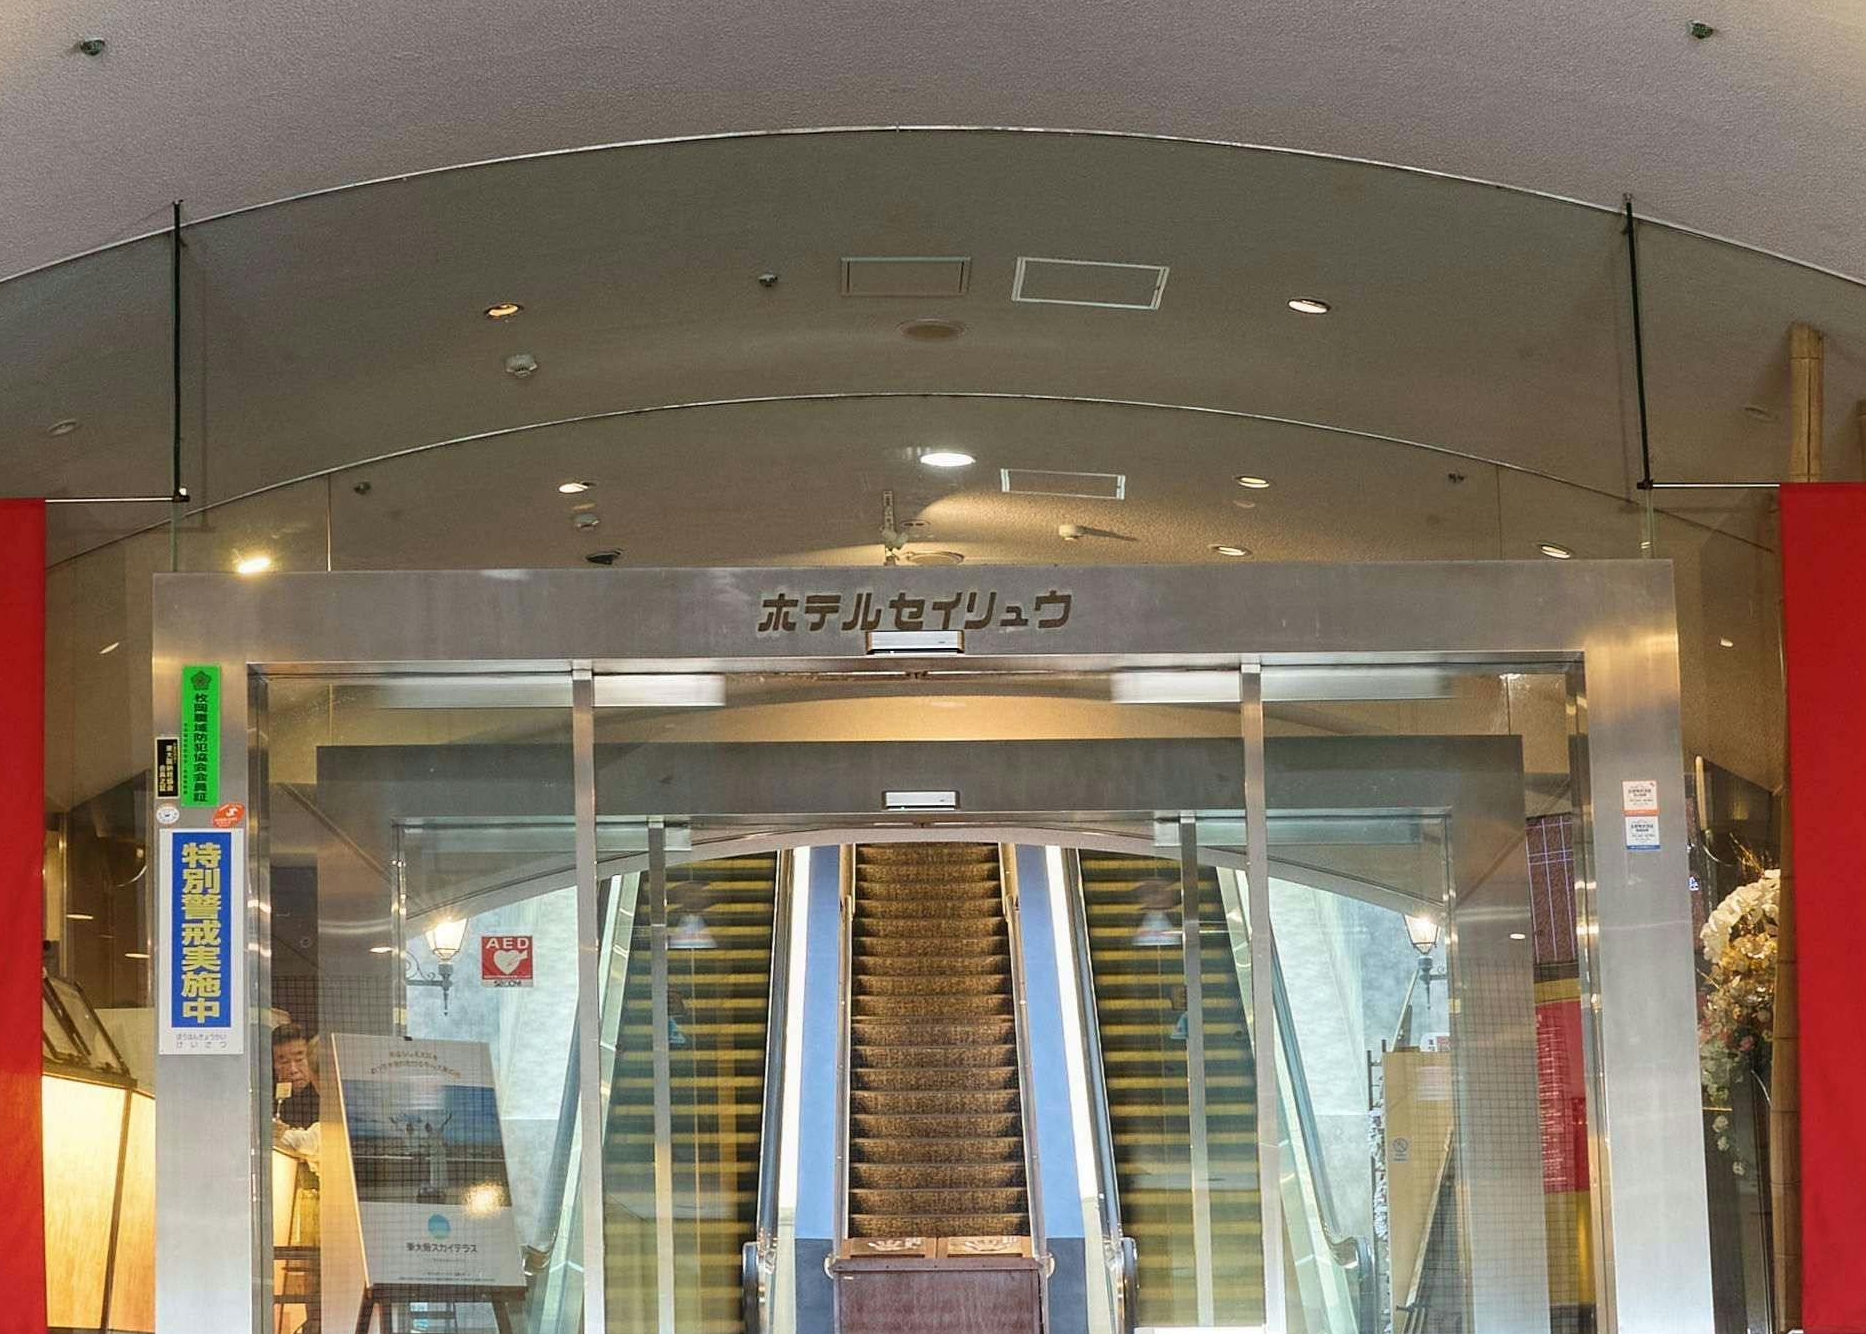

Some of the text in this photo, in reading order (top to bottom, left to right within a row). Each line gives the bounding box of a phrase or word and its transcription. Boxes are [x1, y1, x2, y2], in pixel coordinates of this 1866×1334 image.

[757, 590, 1072, 631] ホテルセイリュウ
[181, 842, 222, 1024] 特別警戒実施中
[486, 938, 529, 949] AED
